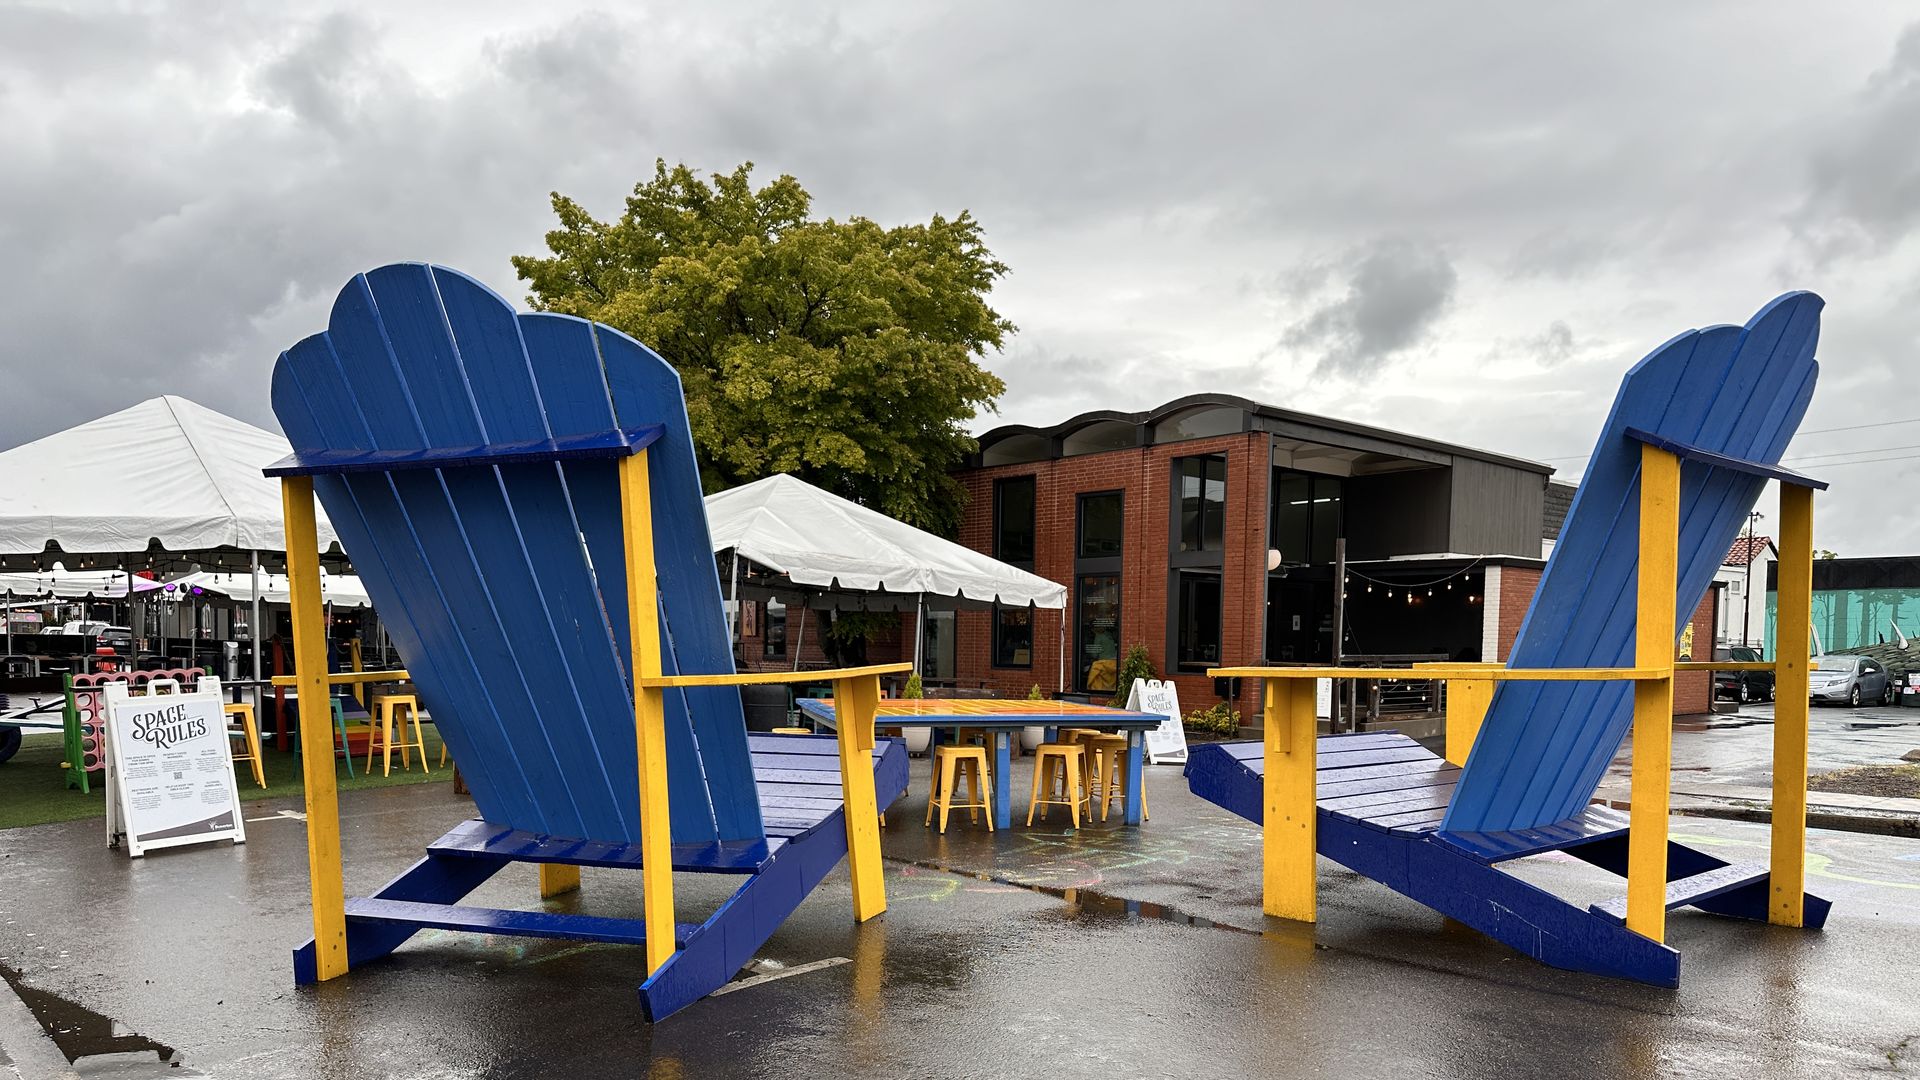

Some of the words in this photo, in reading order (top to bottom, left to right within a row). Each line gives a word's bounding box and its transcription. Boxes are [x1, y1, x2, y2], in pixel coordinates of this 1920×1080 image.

[1147, 693, 1165, 708] SPACE
[132, 704, 187, 740] SPACE
[145, 718, 207, 749] RULES
